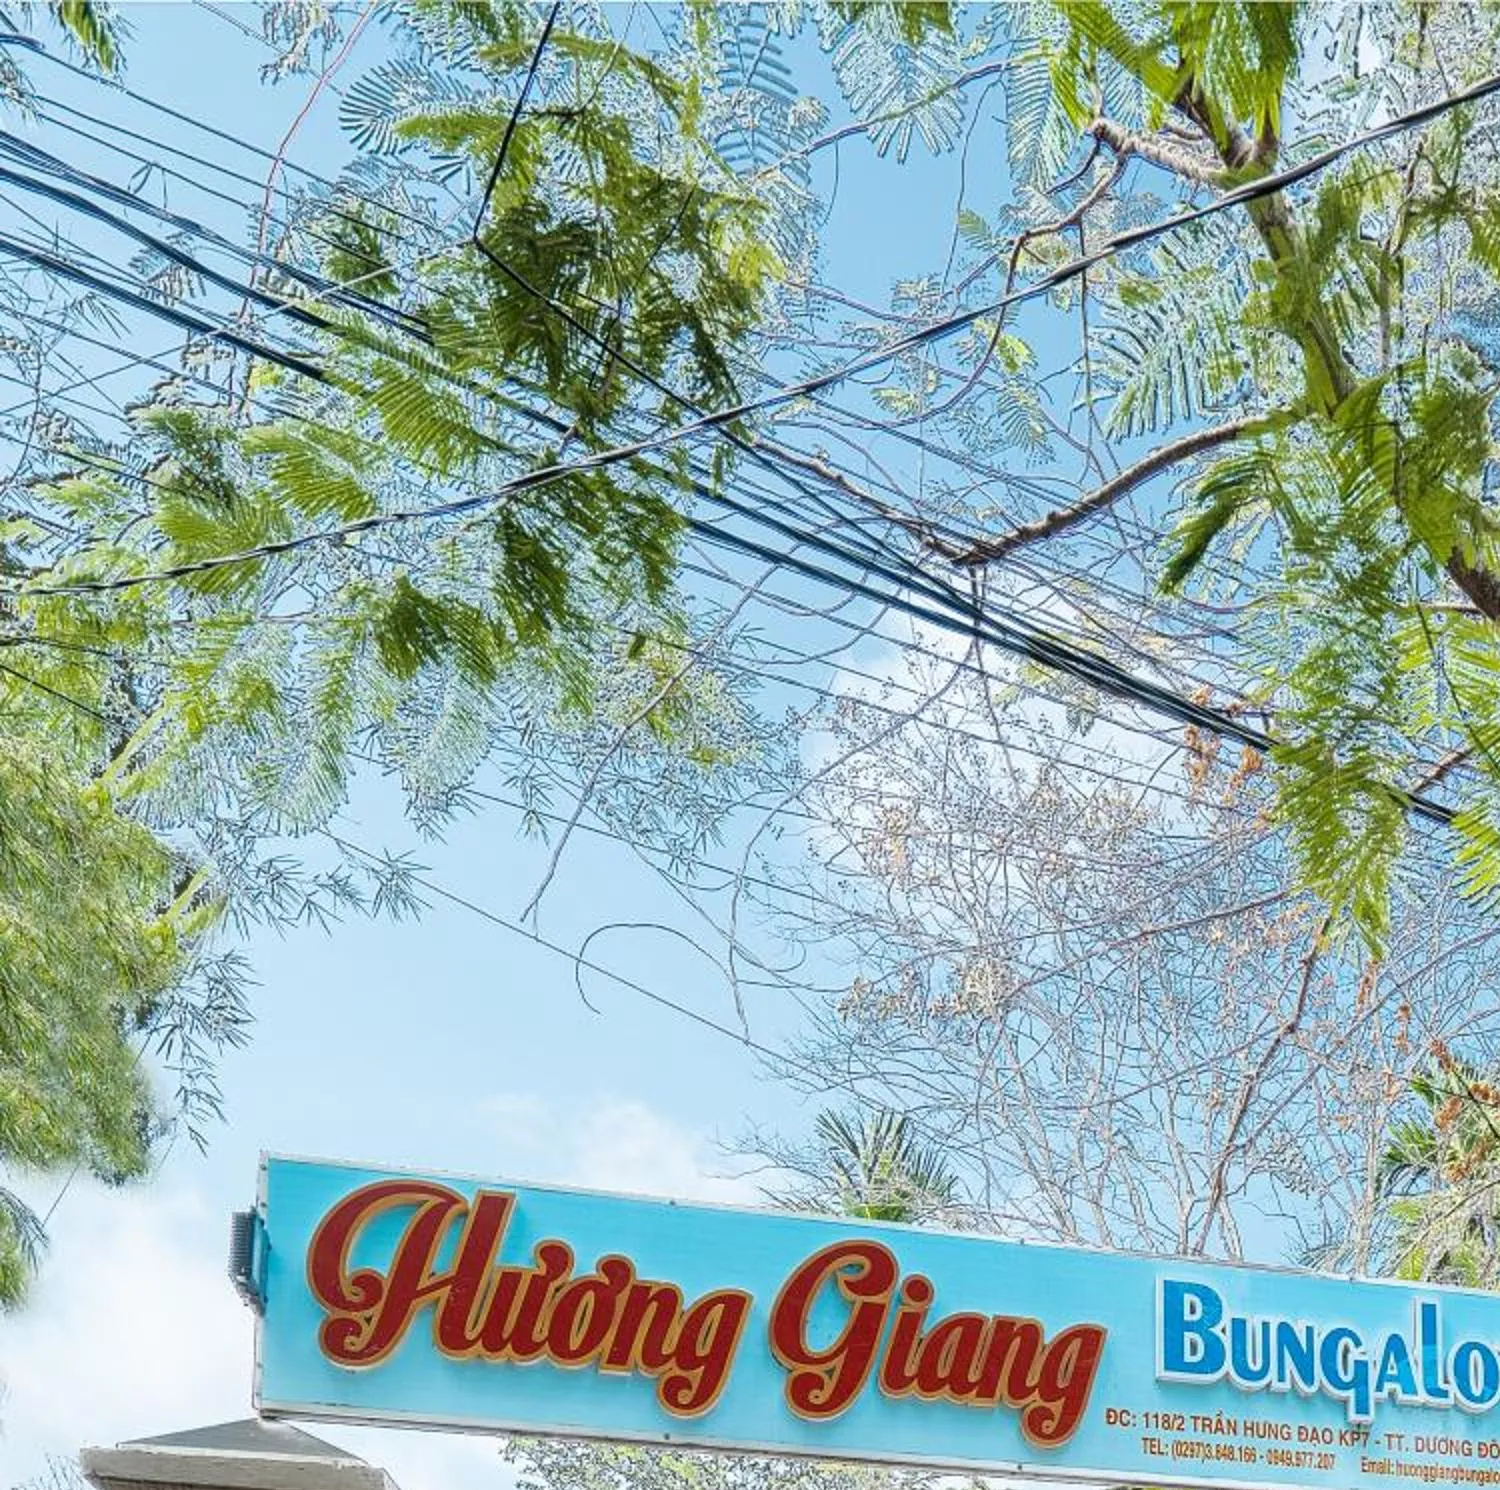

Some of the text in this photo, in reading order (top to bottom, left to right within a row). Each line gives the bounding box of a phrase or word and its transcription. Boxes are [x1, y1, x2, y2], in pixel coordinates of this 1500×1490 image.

[307, 1178, 753, 1418] Hương
[769, 1239, 1108, 1449] Giang
[1105, 1407, 1137, 1428] ĐC:
[1143, 1411, 1185, 1432] 118/2
[1141, 1437, 1169, 1456] TEL:
